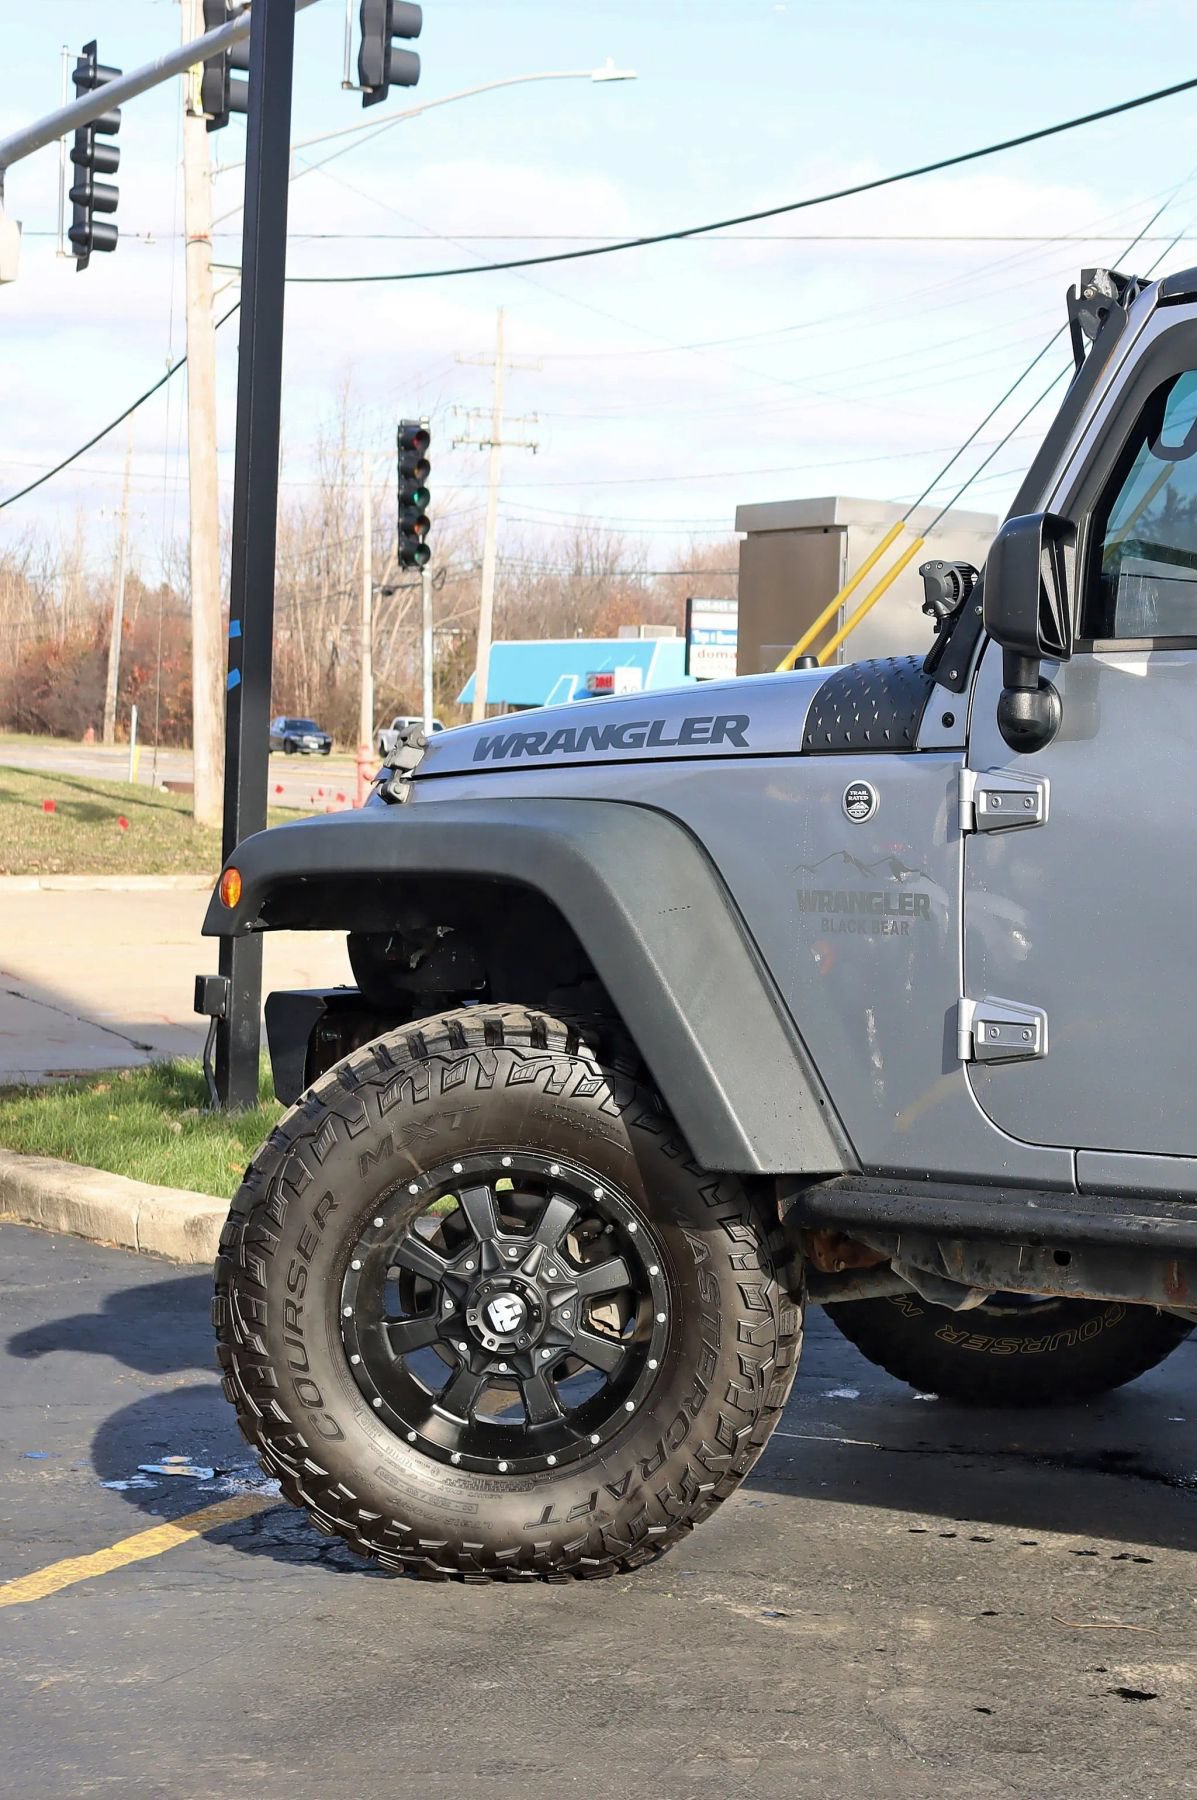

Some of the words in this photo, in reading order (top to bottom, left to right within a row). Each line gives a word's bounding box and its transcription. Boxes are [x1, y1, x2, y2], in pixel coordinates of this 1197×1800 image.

[472, 714, 750, 762] WRANGLER
[797, 889, 931, 921] WRANGLER
[820, 917, 867, 934] BLACK
[871, 919, 910, 936] BEAR
[282, 1189, 346, 1442] COURSER
[358, 1104, 482, 1179] MXT
[935, 1302, 1127, 1355] COURSER
